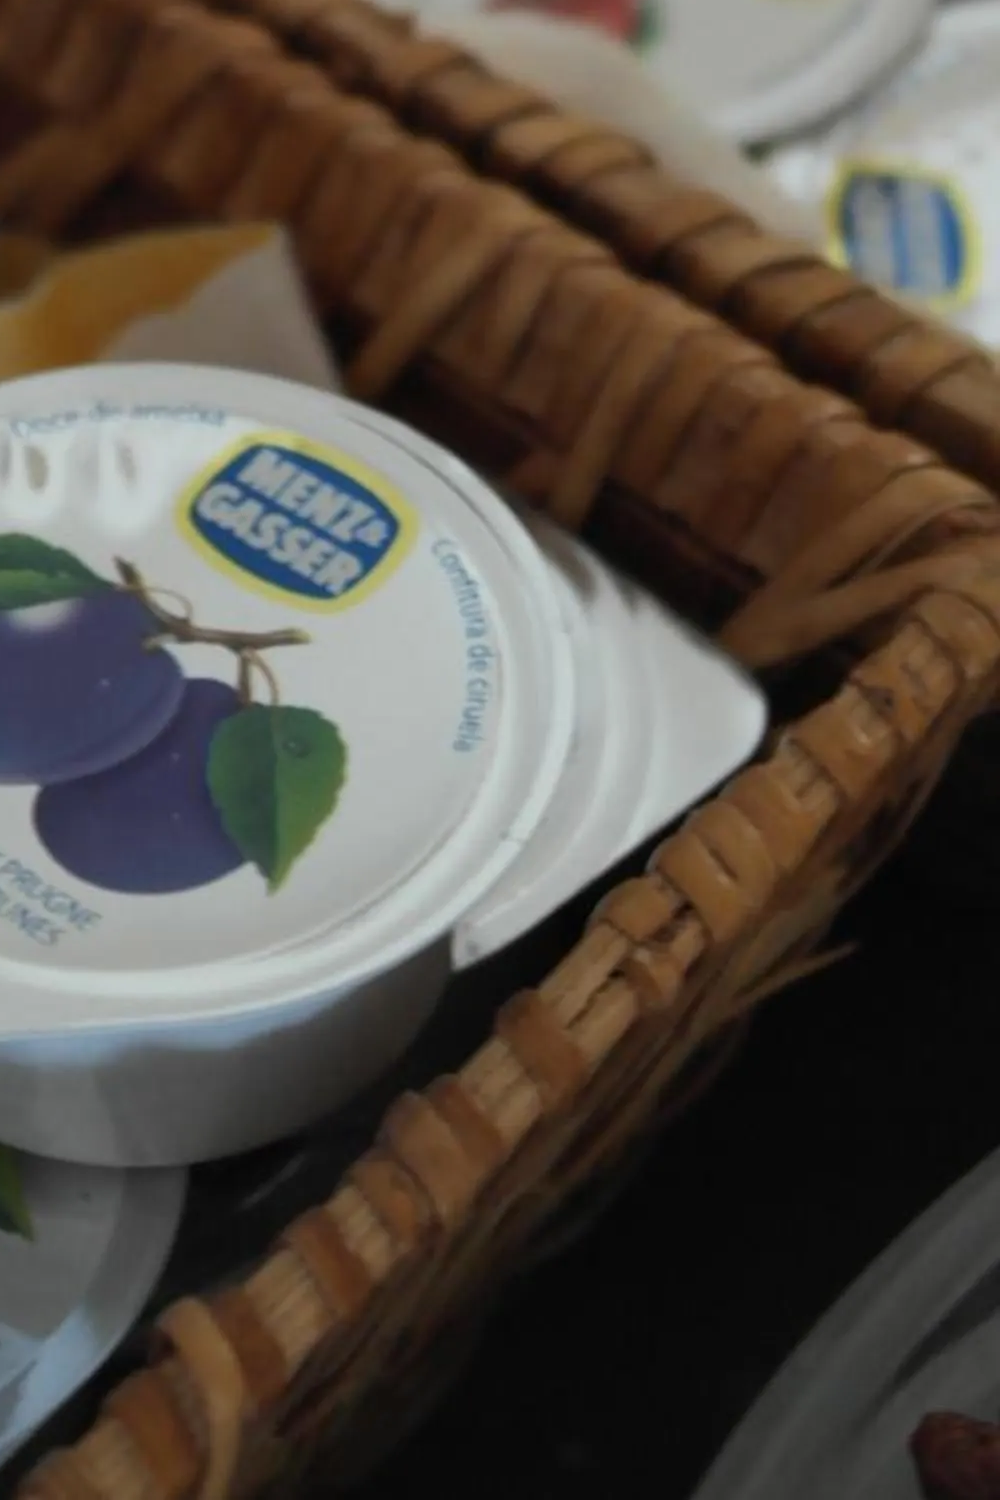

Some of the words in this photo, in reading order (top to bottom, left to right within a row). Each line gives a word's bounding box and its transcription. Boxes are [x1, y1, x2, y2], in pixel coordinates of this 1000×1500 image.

[197, 482, 362, 594] GASSER
[431, 538, 490, 640] Confitura
[467, 645, 494, 672] de
[453, 677, 490, 753] ciruela
